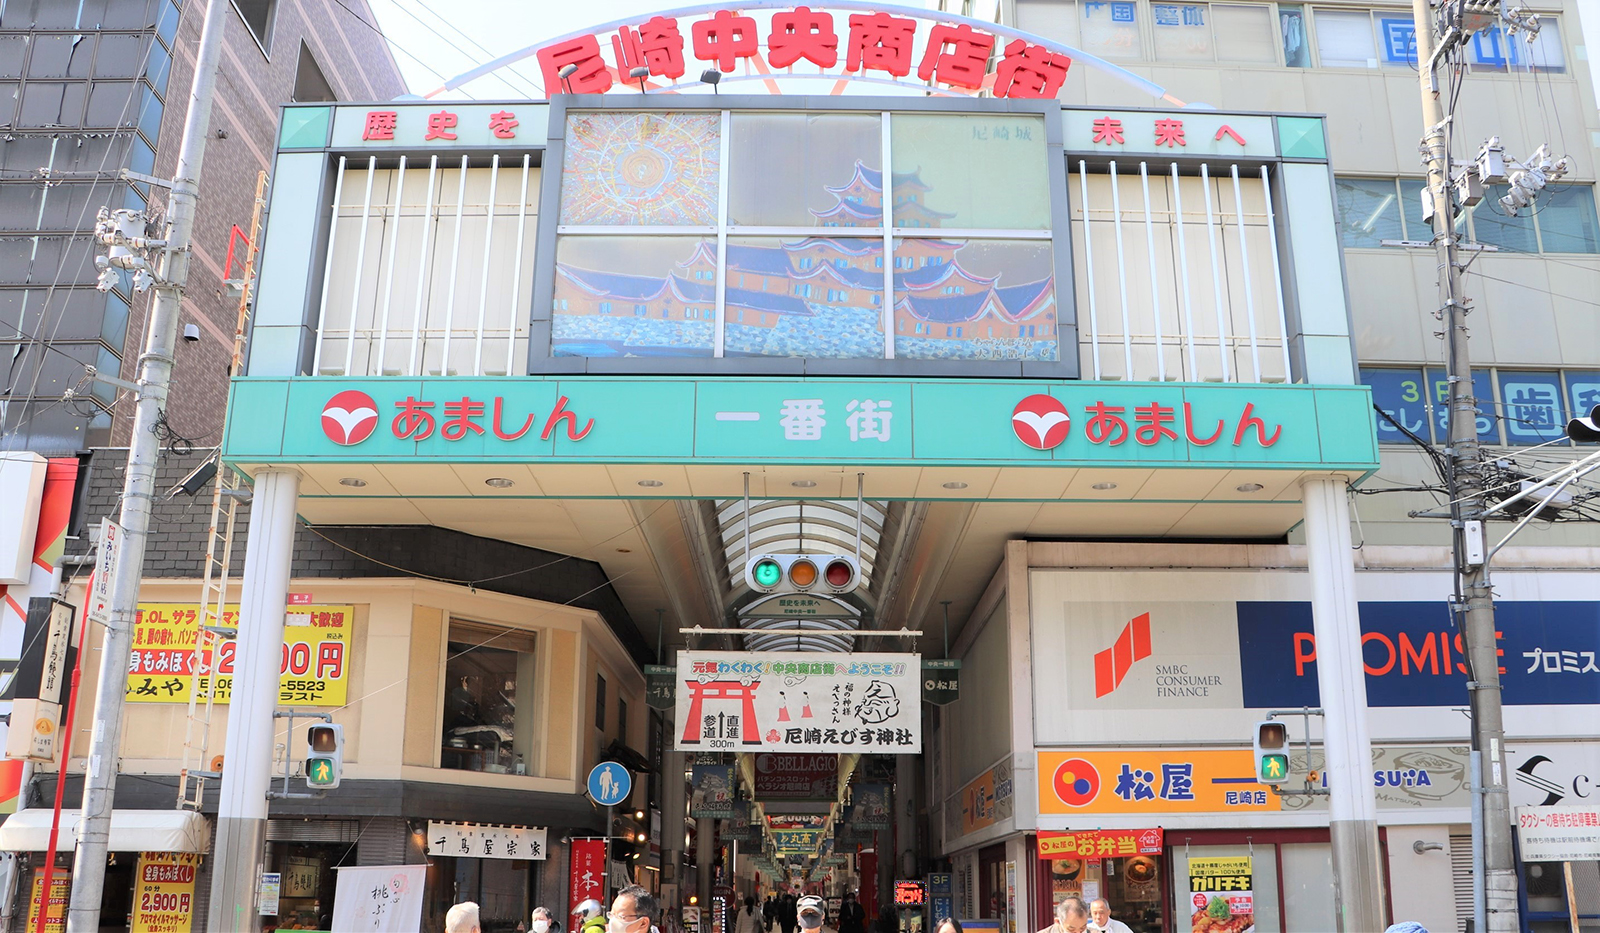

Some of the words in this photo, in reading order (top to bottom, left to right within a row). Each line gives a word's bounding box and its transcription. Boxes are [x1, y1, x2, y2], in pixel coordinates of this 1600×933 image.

[537, 5, 1072, 99] 尼崎中央商店街
[362, 110, 519, 141] 歴史を
[971, 124, 1033, 142] 尼崎城
[1091, 115, 1247, 147] 未来へ
[391, 395, 594, 442] あましん
[715, 398, 893, 442] 一番街
[1084, 400, 1282, 448] あましん
[779, 599, 821, 607] 歴史を未来へ
[1155, 664, 1189, 675] SMBC
[1522, 646, 1600, 675] プロミス
[124, 677, 184, 698] みや
[936, 680, 958, 691] 松屋
[1155, 675, 1223, 686] CONSUMER
[1156, 686, 1210, 697] FINANCE
[703, 715, 717, 739] 参道
[726, 715, 740, 739] 直進
[784, 727, 914, 746] 尼崎えびす神社
[709, 740, 735, 749] 300m
[776, 756, 837, 772] BELLAGIO
[1113, 762, 1196, 802] 松屋
[1224, 790, 1268, 806] 尼崎店
[434, 836, 541, 857] 千鳥屋宗家
[1051, 841, 1074, 850] 松屋の
[1077, 836, 1138, 857] お弁当
[932, 875, 949, 885] 3F
[1191, 876, 1251, 892] ガリチキ
